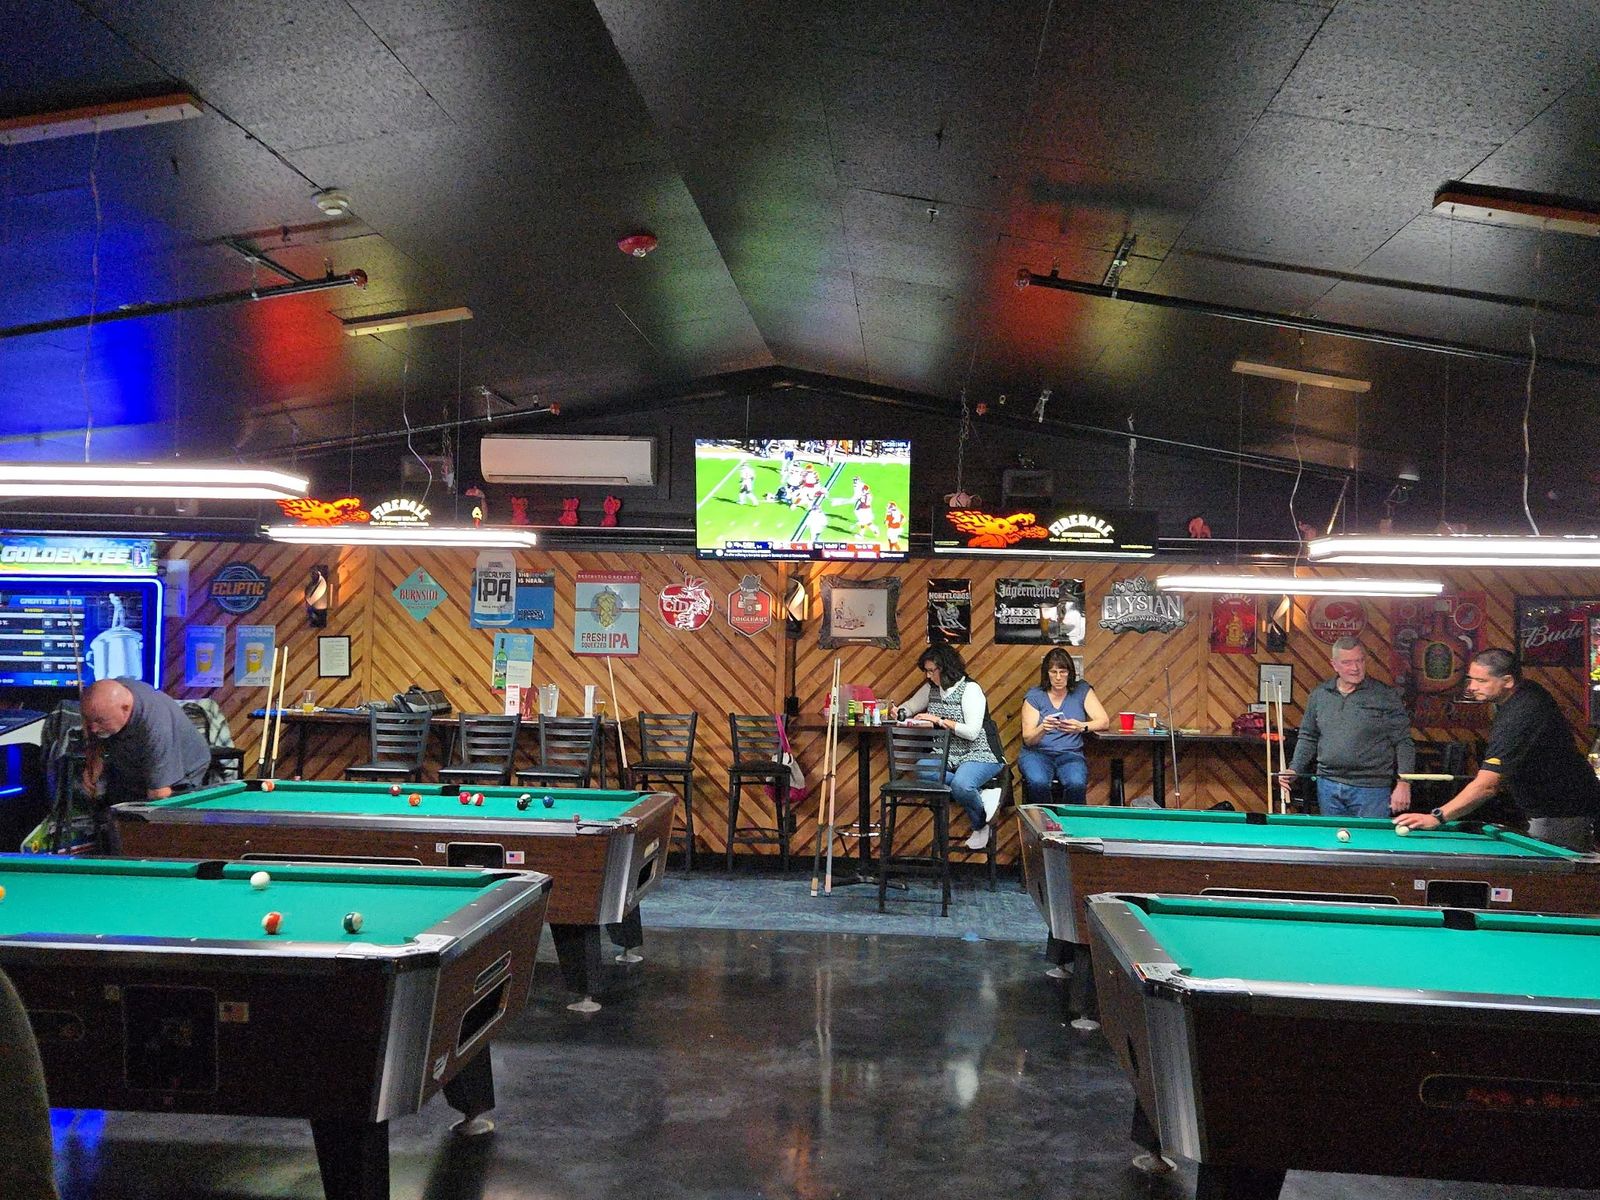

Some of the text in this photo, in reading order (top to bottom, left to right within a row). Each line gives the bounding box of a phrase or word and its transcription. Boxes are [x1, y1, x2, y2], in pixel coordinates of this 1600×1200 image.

[370, 498, 431, 521] FIREBALL
[1048, 514, 1115, 537] FIREBALL
[1, 546, 130, 565] GOLDEN TEE
[212, 581, 265, 596] ECLIPTIC
[477, 578, 512, 602] IPA
[999, 583, 1060, 599] Jägermeister
[1103, 594, 1184, 620] ELYSIAN
[581, 633, 630, 649] FRESH IPA
